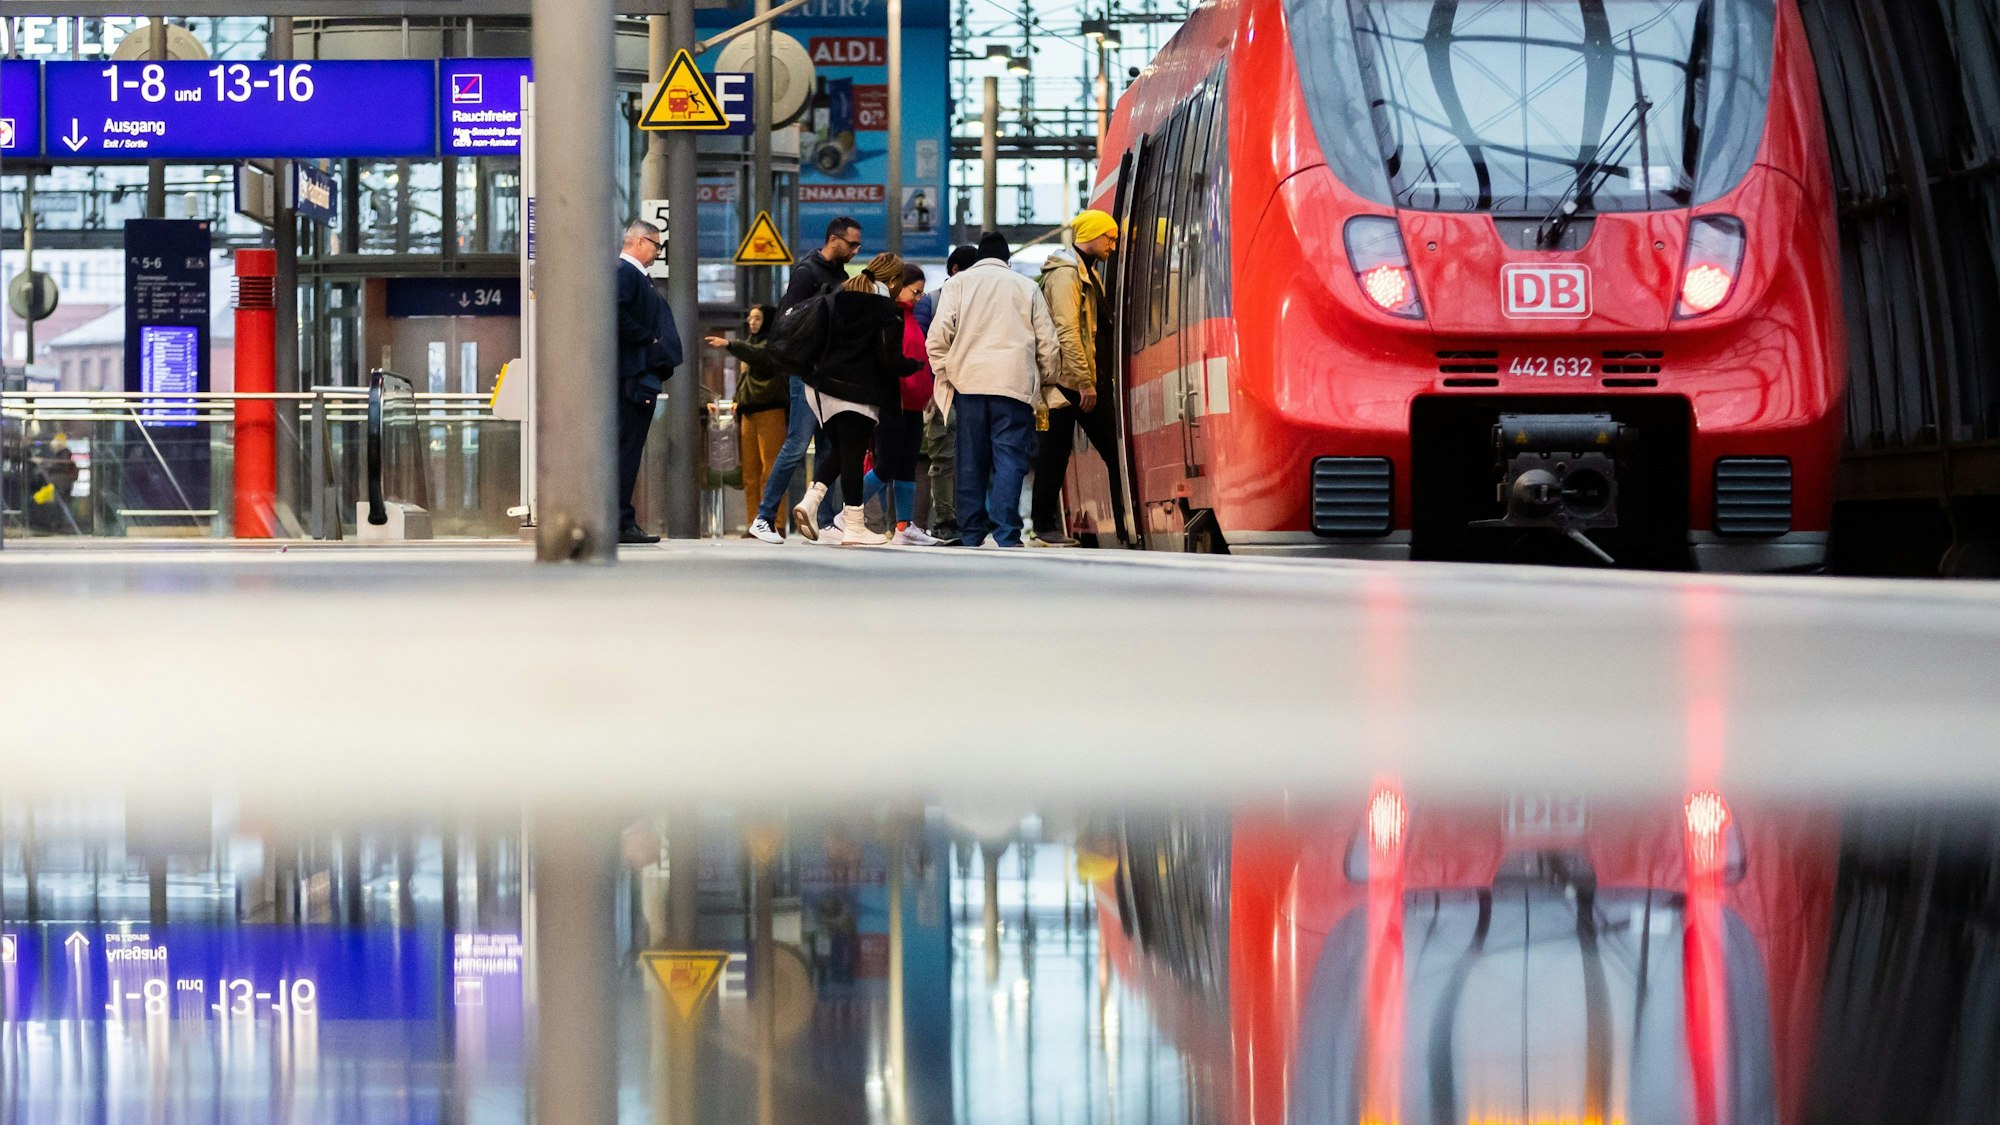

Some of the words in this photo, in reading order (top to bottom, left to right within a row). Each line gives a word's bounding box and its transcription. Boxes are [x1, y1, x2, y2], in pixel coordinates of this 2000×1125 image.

[814, 41, 882, 62] ALDI.
[102, 64, 166, 102] 1-8
[175, 88, 202, 102] und
[209, 63, 314, 102] 13-16
[716, 75, 746, 121] E
[452, 109, 518, 122] Rauchfreier
[103, 118, 166, 136] Ausgang
[103, 139, 119, 149] Exit
[124, 139, 149, 149] Sortie
[799, 186, 883, 200] ENMARKE.
[656, 206, 669, 232] 5
[142, 257, 162, 269] 5-6
[474, 289, 502, 305] 3/4
[1512, 272, 1581, 310] DB
[1508, 357, 1548, 377] 442
[1553, 357, 1593, 377] 632
